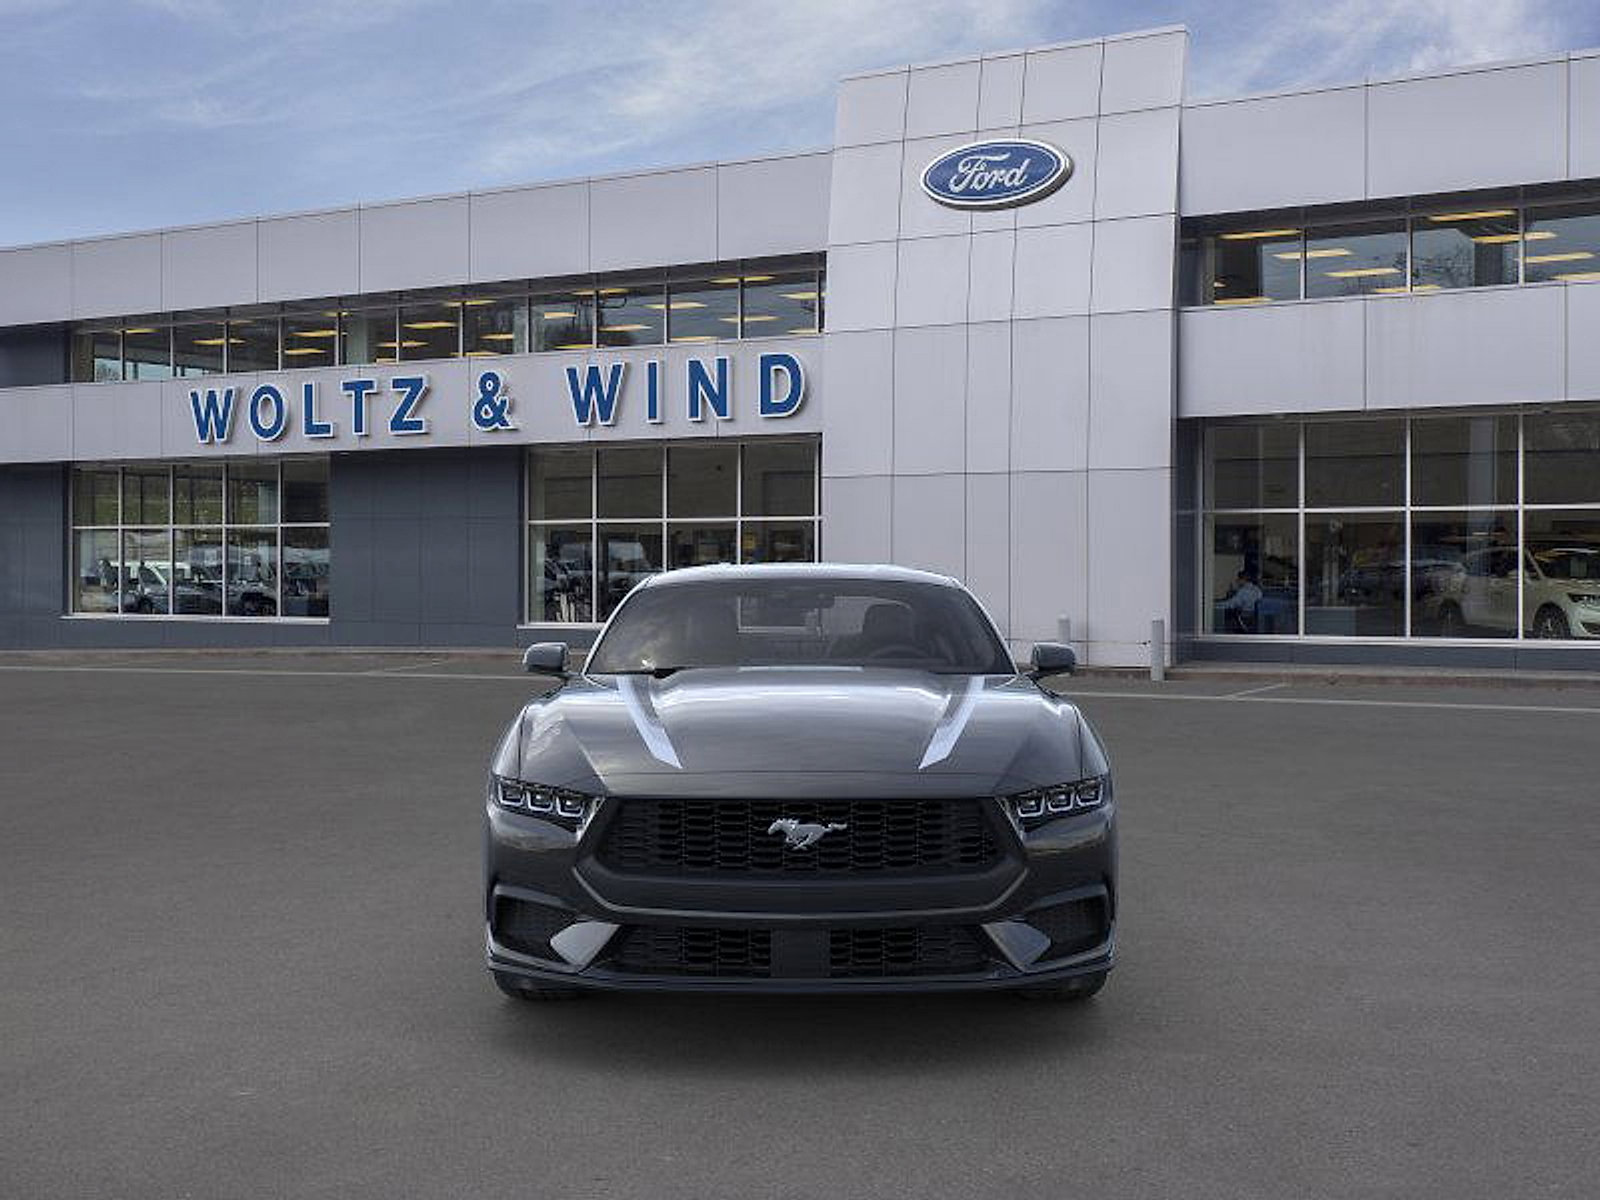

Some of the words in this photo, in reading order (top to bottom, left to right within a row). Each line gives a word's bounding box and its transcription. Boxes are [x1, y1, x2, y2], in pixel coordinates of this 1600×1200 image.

[950, 152, 1031, 193] Ford
[190, 376, 428, 444] WOLTZ
[472, 370, 514, 431] &
[566, 351, 806, 426] WIND
